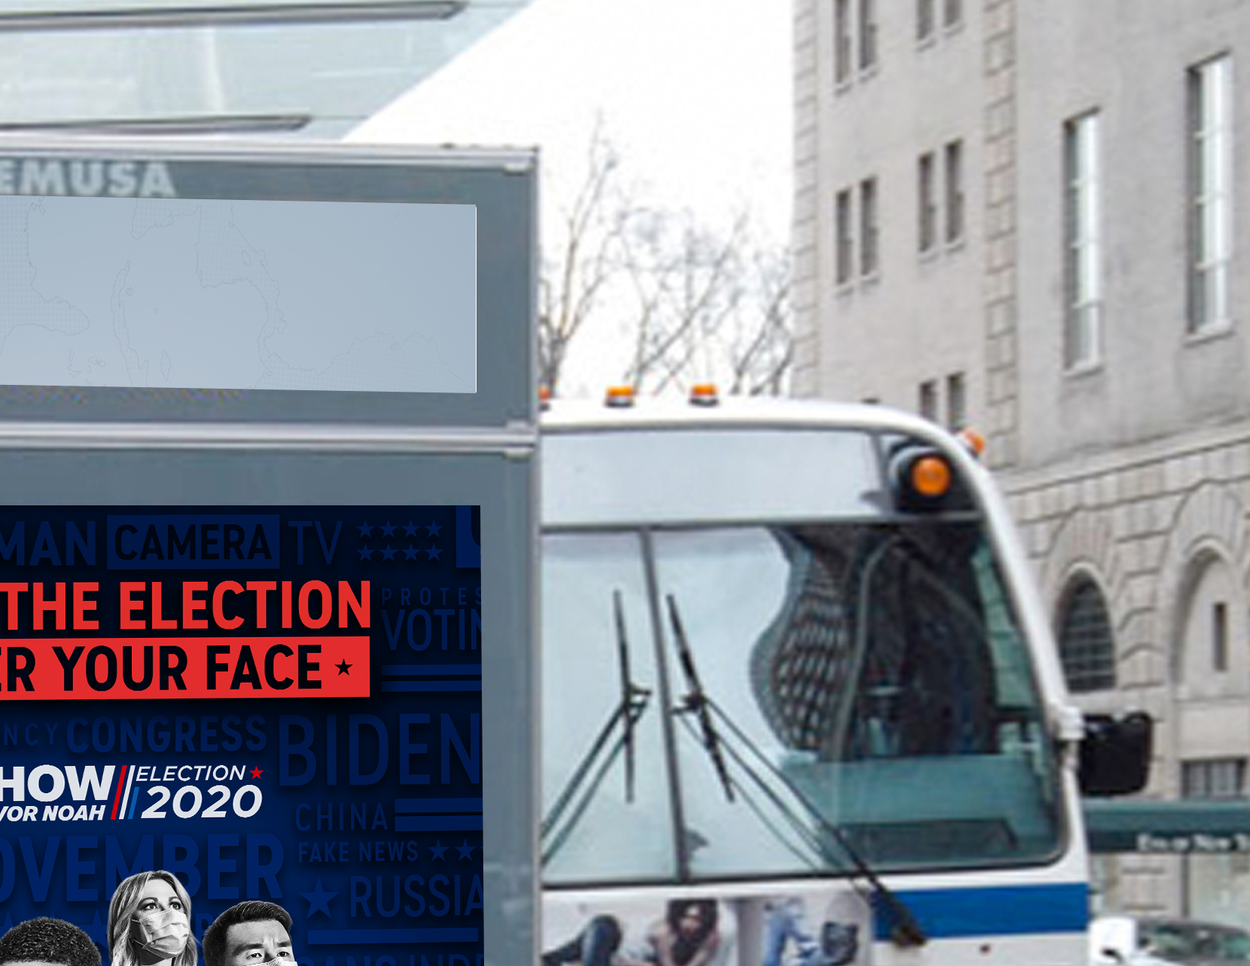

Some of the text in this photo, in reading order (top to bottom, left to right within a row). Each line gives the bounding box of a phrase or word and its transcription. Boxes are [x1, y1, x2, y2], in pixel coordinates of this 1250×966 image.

[114, 523, 272, 562] CAMERA
[288, 520, 344, 566] TV
[120, 580, 370, 629] ELECTION
[52, 646, 187, 691] YOUR
[207, 644, 321, 690] FACE
[66, 714, 267, 754] CONGRESS
[279, 712, 481, 787] BIDEN
[136, 765, 247, 781] ELECTION
[42, 805, 106, 821] NOAH
[141, 785, 262, 818] 2020
[294, 802, 389, 832] CHINA
[298, 840, 419, 863] FAKE NEWS
[350, 873, 484, 918] RUSSIA
